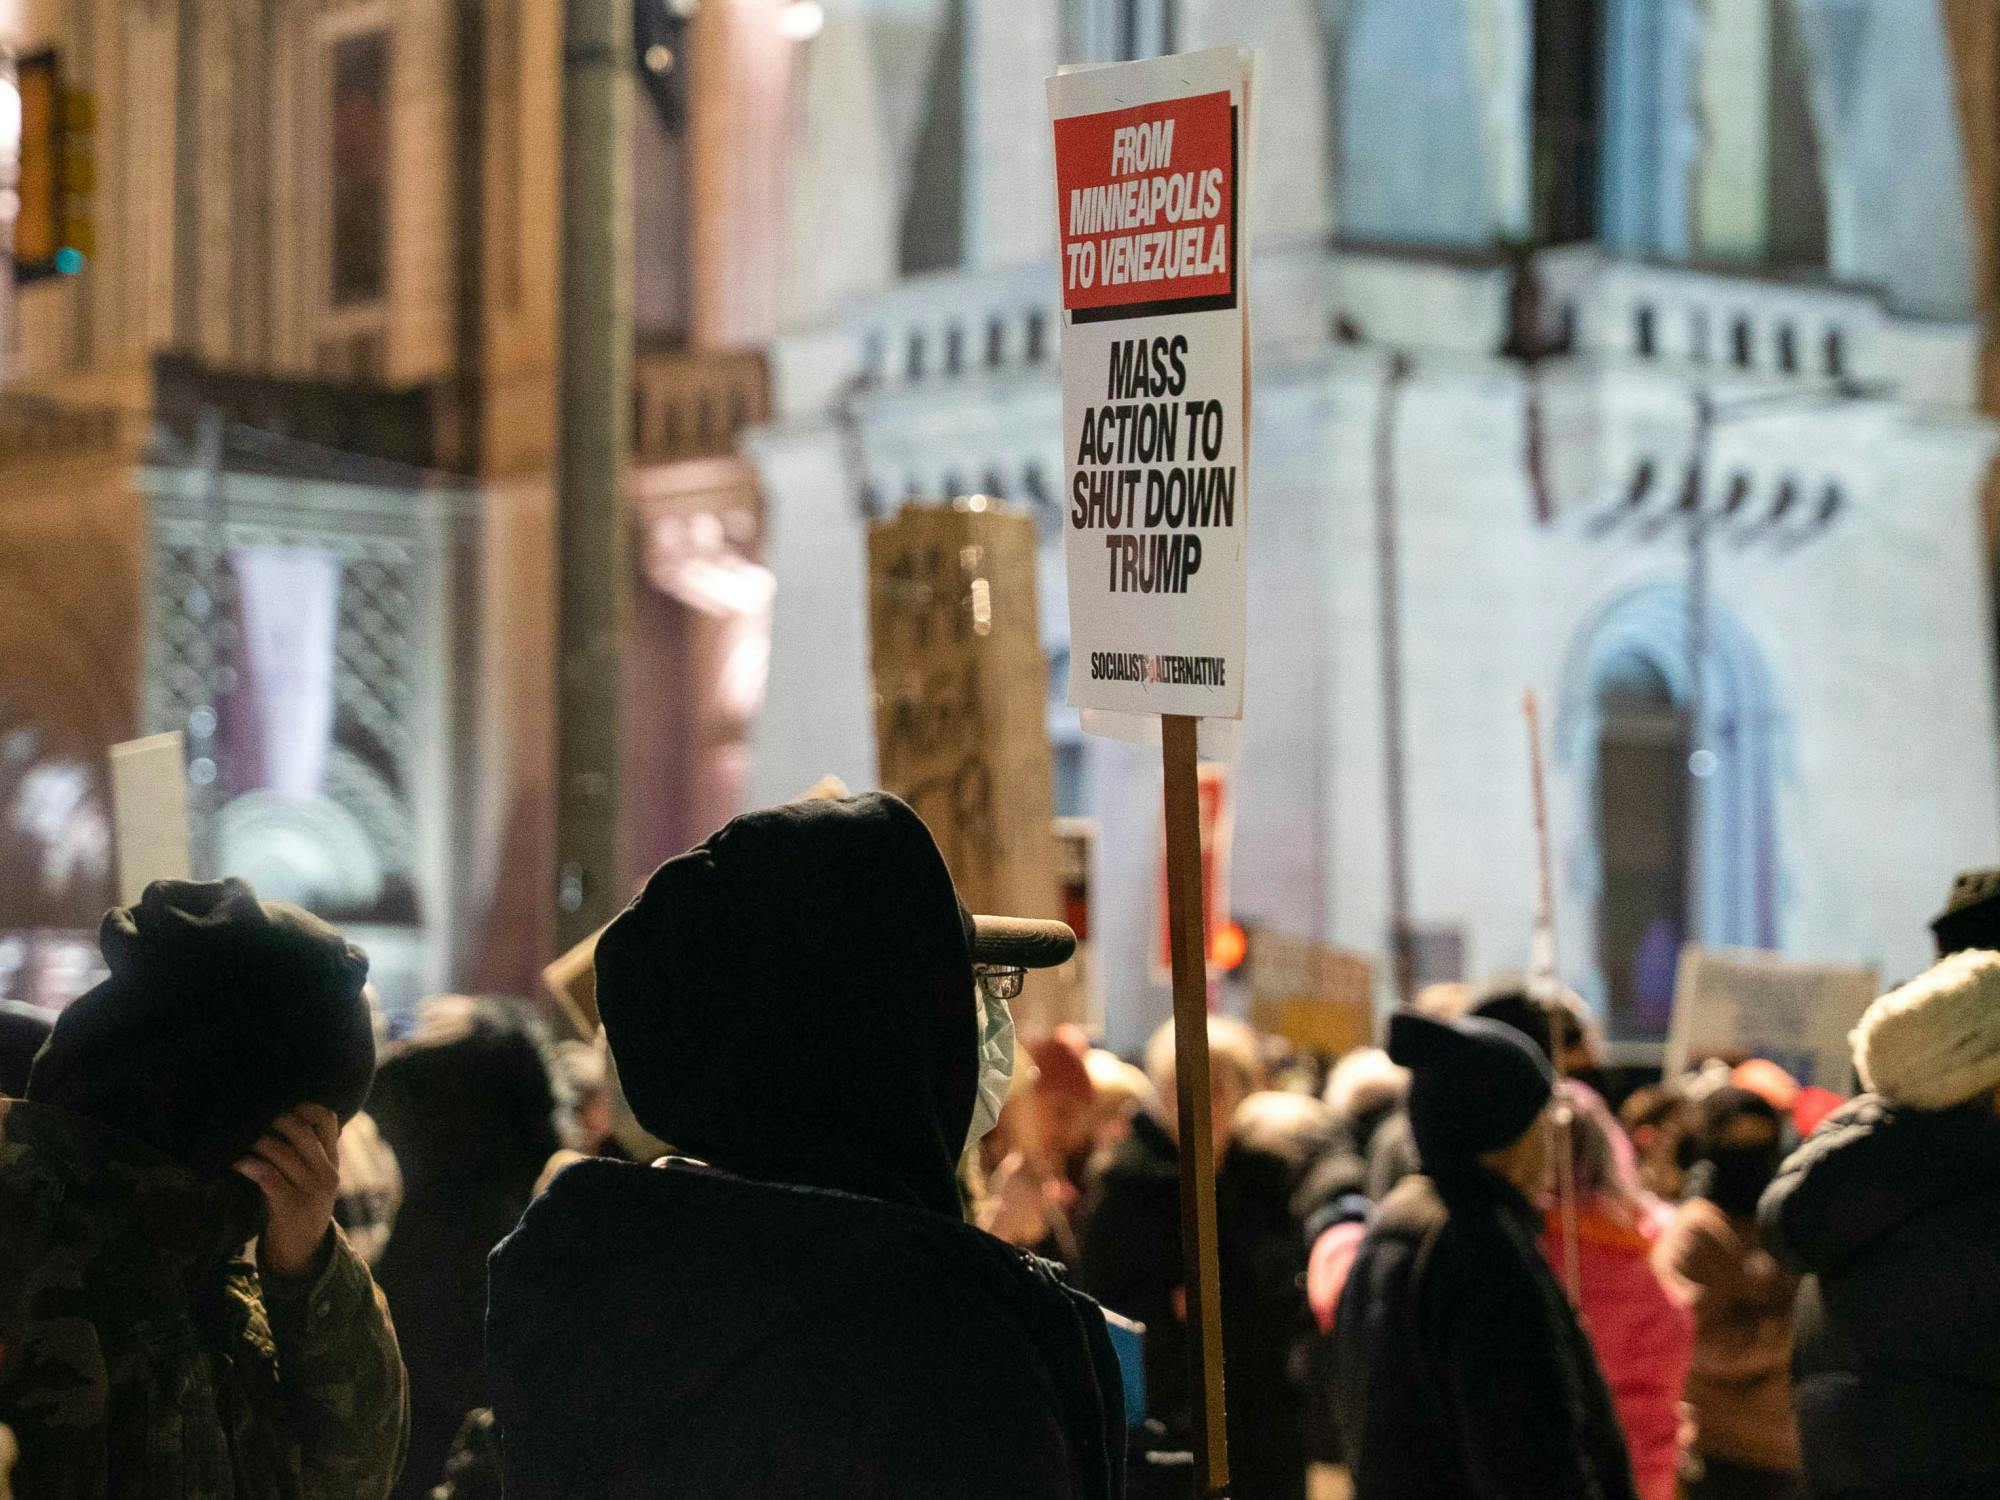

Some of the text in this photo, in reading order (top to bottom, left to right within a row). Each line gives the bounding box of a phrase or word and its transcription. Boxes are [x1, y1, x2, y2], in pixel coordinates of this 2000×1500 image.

[1111, 119, 1175, 176] FROM
[1069, 167, 1224, 236] MINNEAPOLIS
[1067, 224, 1226, 290] TO VENEZUELA
[1107, 334, 1188, 400] MASS
[1077, 399, 1224, 466] ACTION TO
[1071, 466, 1236, 530] SHUT DOWN
[1106, 534, 1202, 594] TRUMP
